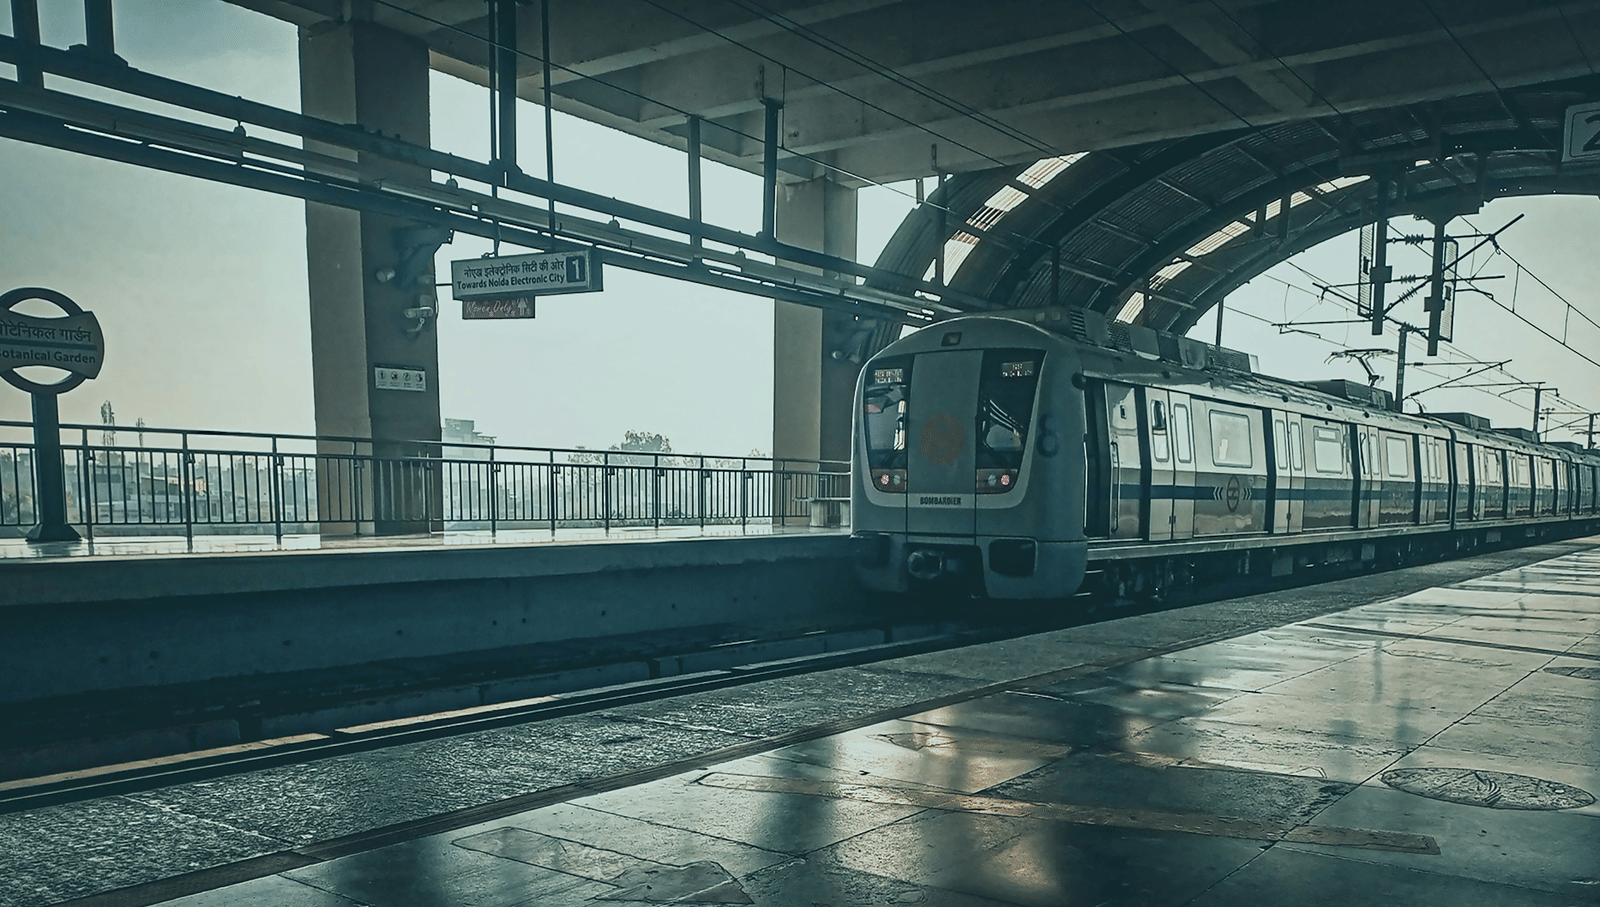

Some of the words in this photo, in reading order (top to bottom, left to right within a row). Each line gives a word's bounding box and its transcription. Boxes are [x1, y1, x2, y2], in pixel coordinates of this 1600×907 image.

[522, 260, 538, 273] सिटी
[539, 258, 549, 271] की
[550, 257, 565, 271] ओर
[571, 258, 580, 281] 1
[457, 279, 488, 290] Towards
[488, 277, 510, 288] Noida
[511, 274, 548, 286] Electronic
[549, 272, 565, 284] City
[60, 325, 93, 343] गार्डन
[0, 348, 51, 361] otanical
[53, 351, 96, 364] Garden
[919, 496, 962, 506] BOMBARDIER
